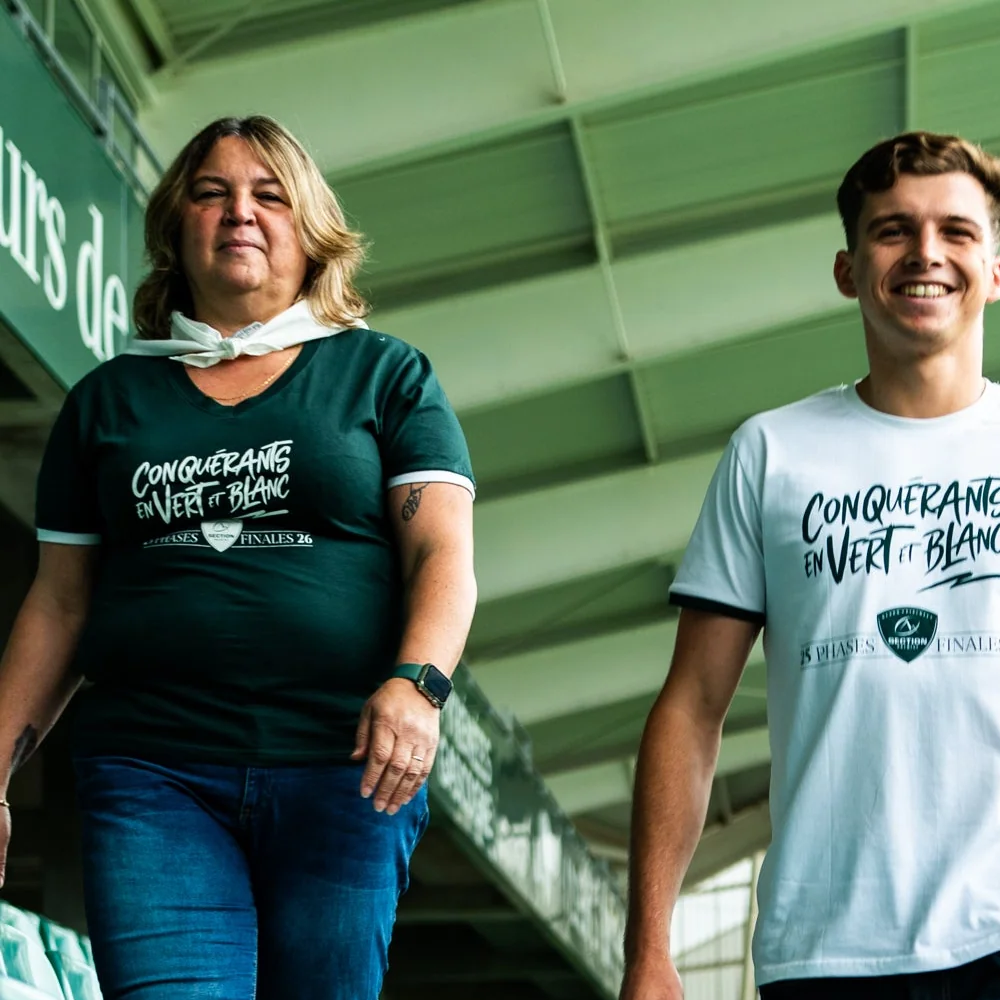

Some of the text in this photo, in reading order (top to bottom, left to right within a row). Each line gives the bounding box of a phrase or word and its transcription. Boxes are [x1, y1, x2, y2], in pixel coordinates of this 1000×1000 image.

[132, 440, 293, 498] CONQUÉRANTS
[136, 474, 290, 524] EN VERT ET BLANC
[240, 533, 313, 545] FINALES 26
[804, 548, 824, 578] EN
[826, 524, 915, 584] VERT
[899, 543, 921, 564] ET
[816, 637, 875, 661] PHASES
